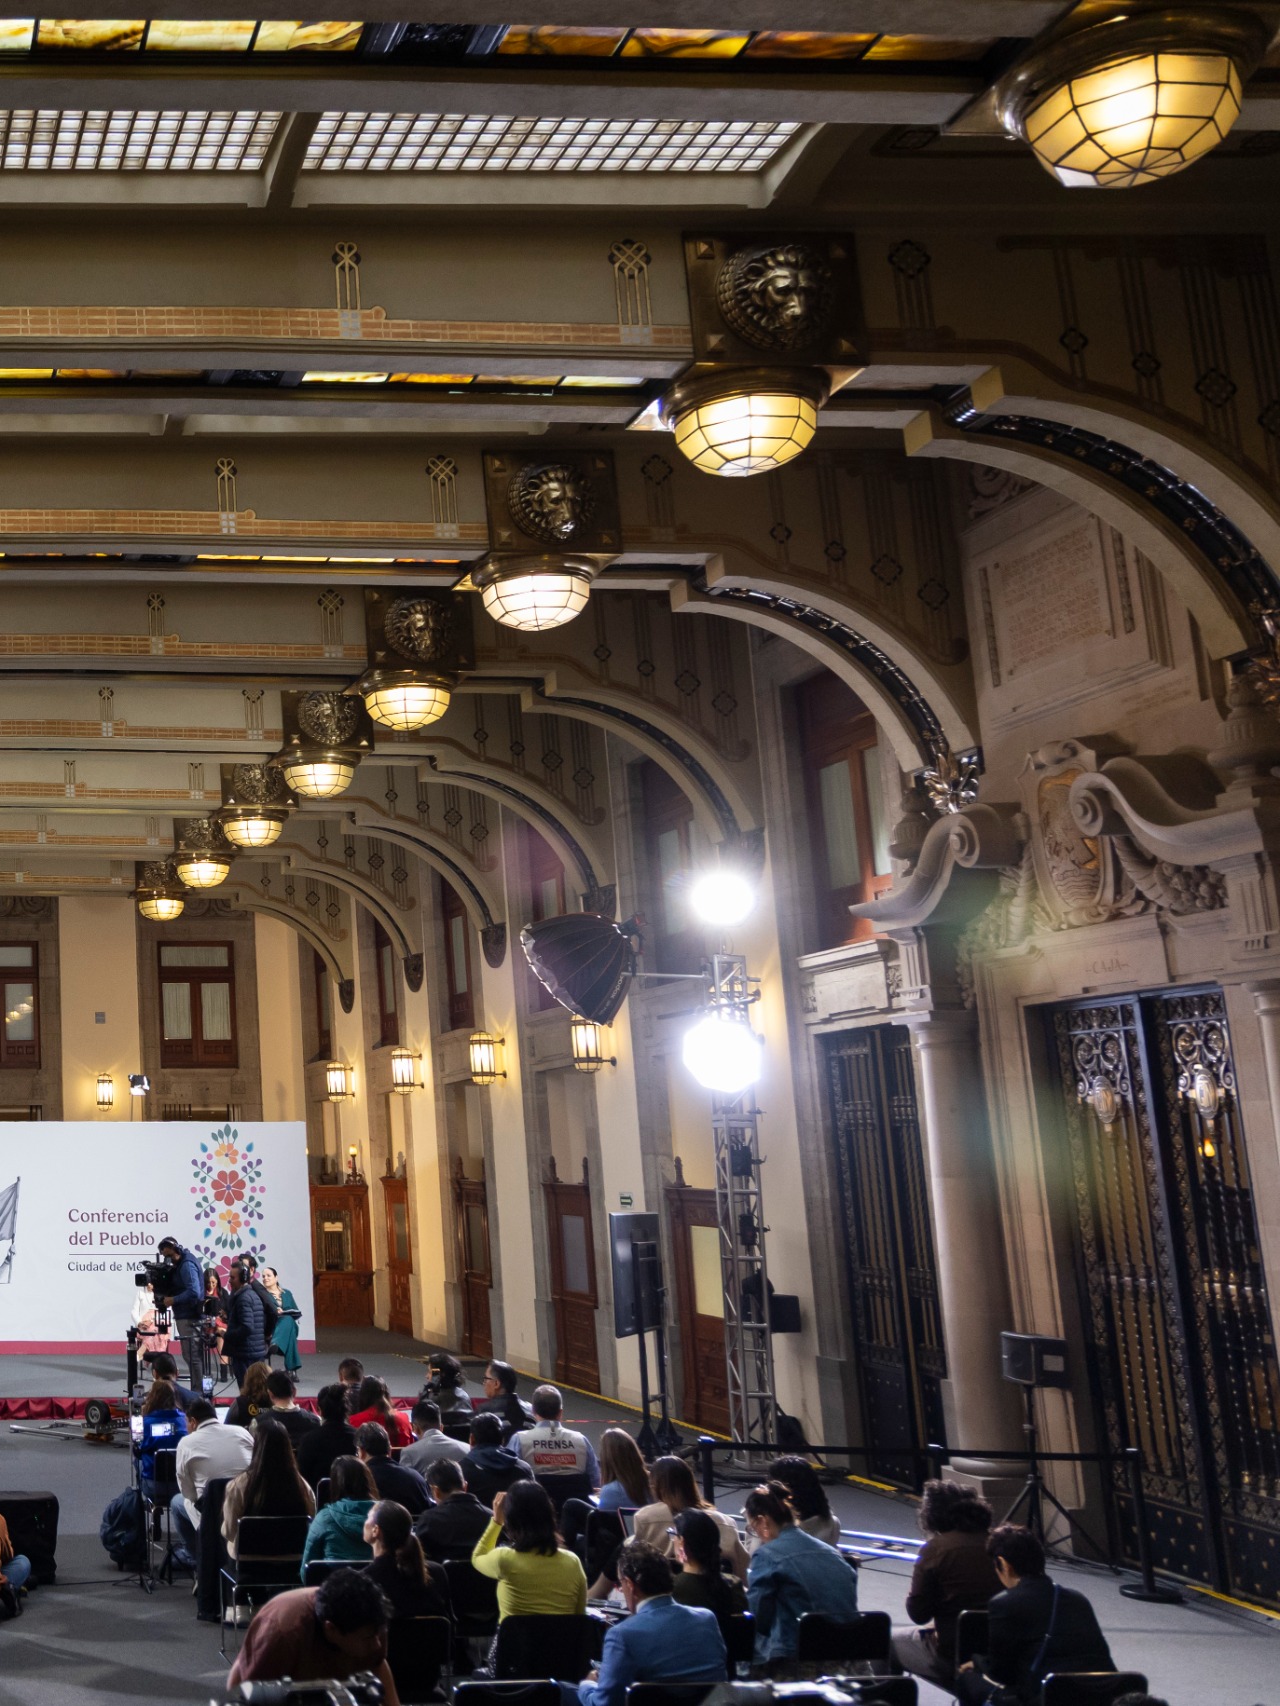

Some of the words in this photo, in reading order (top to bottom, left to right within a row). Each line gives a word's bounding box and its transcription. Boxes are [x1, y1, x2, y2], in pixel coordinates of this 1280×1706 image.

[68, 1208, 169, 1223] Conferencia
[68, 1231, 93, 1246] del
[99, 1231, 155, 1246] Pueblo
[67, 1261, 106, 1272] Ciudad
[109, 1261, 123, 1272] de
[533, 1440, 575, 1449] PRENSA
